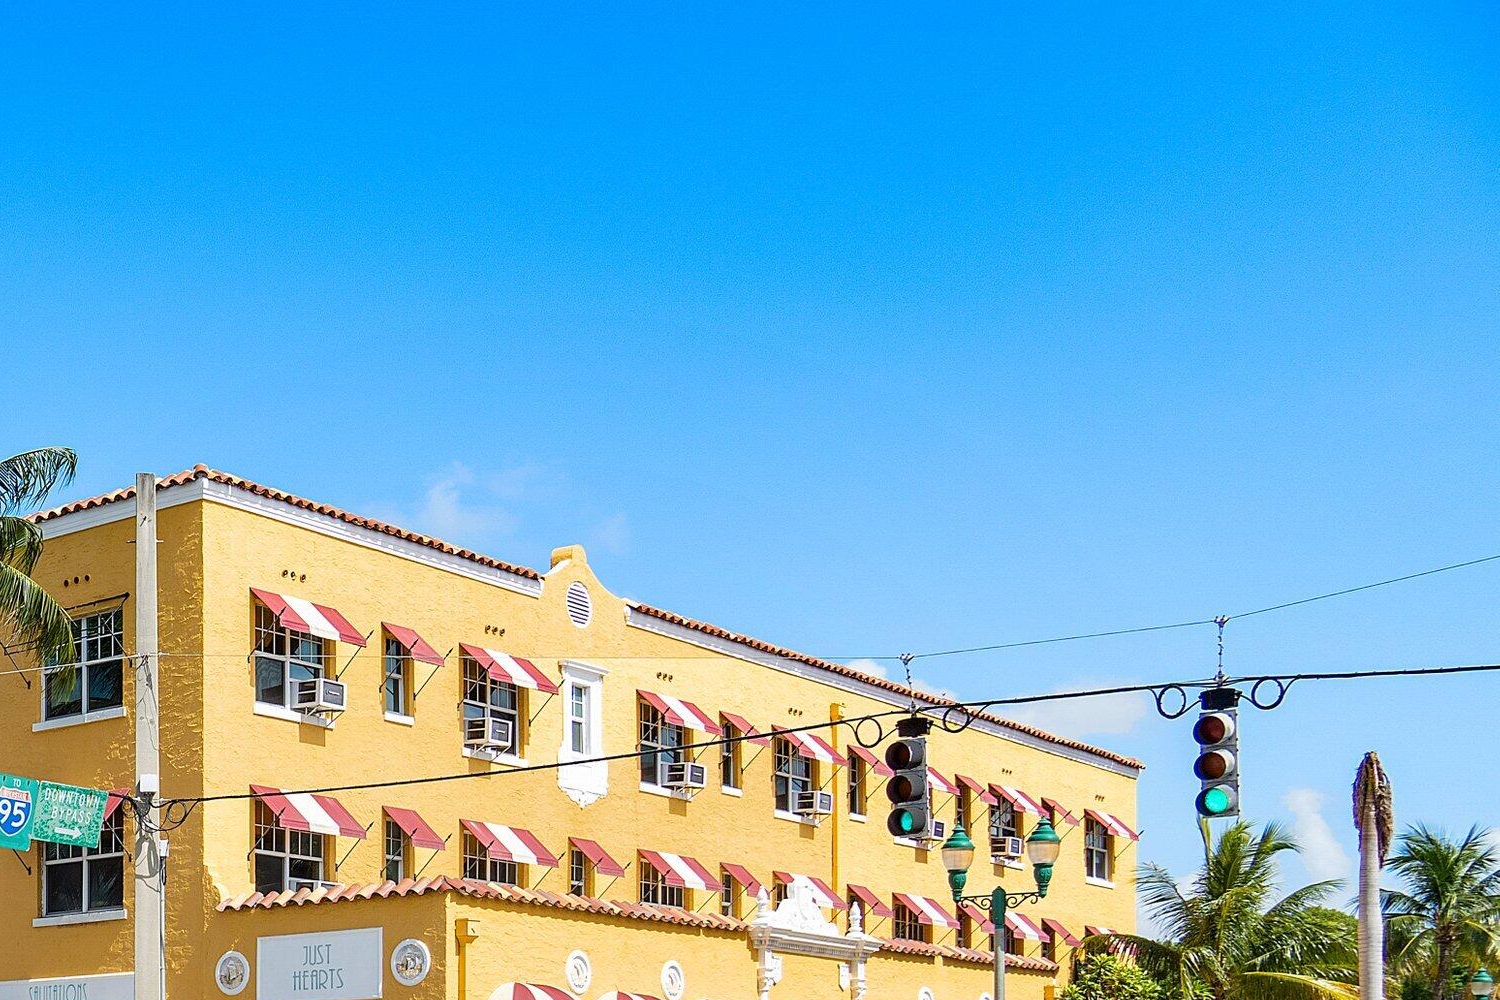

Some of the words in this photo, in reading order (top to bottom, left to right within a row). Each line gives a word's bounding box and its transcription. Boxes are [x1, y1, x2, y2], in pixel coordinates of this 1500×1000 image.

[12, 778, 21, 788] TO
[44, 788, 101, 809] DOWNTOWN
[51, 806, 92, 825] BYPASS
[303, 944, 332, 966] JUST
[293, 968, 344, 991] HEARTS
